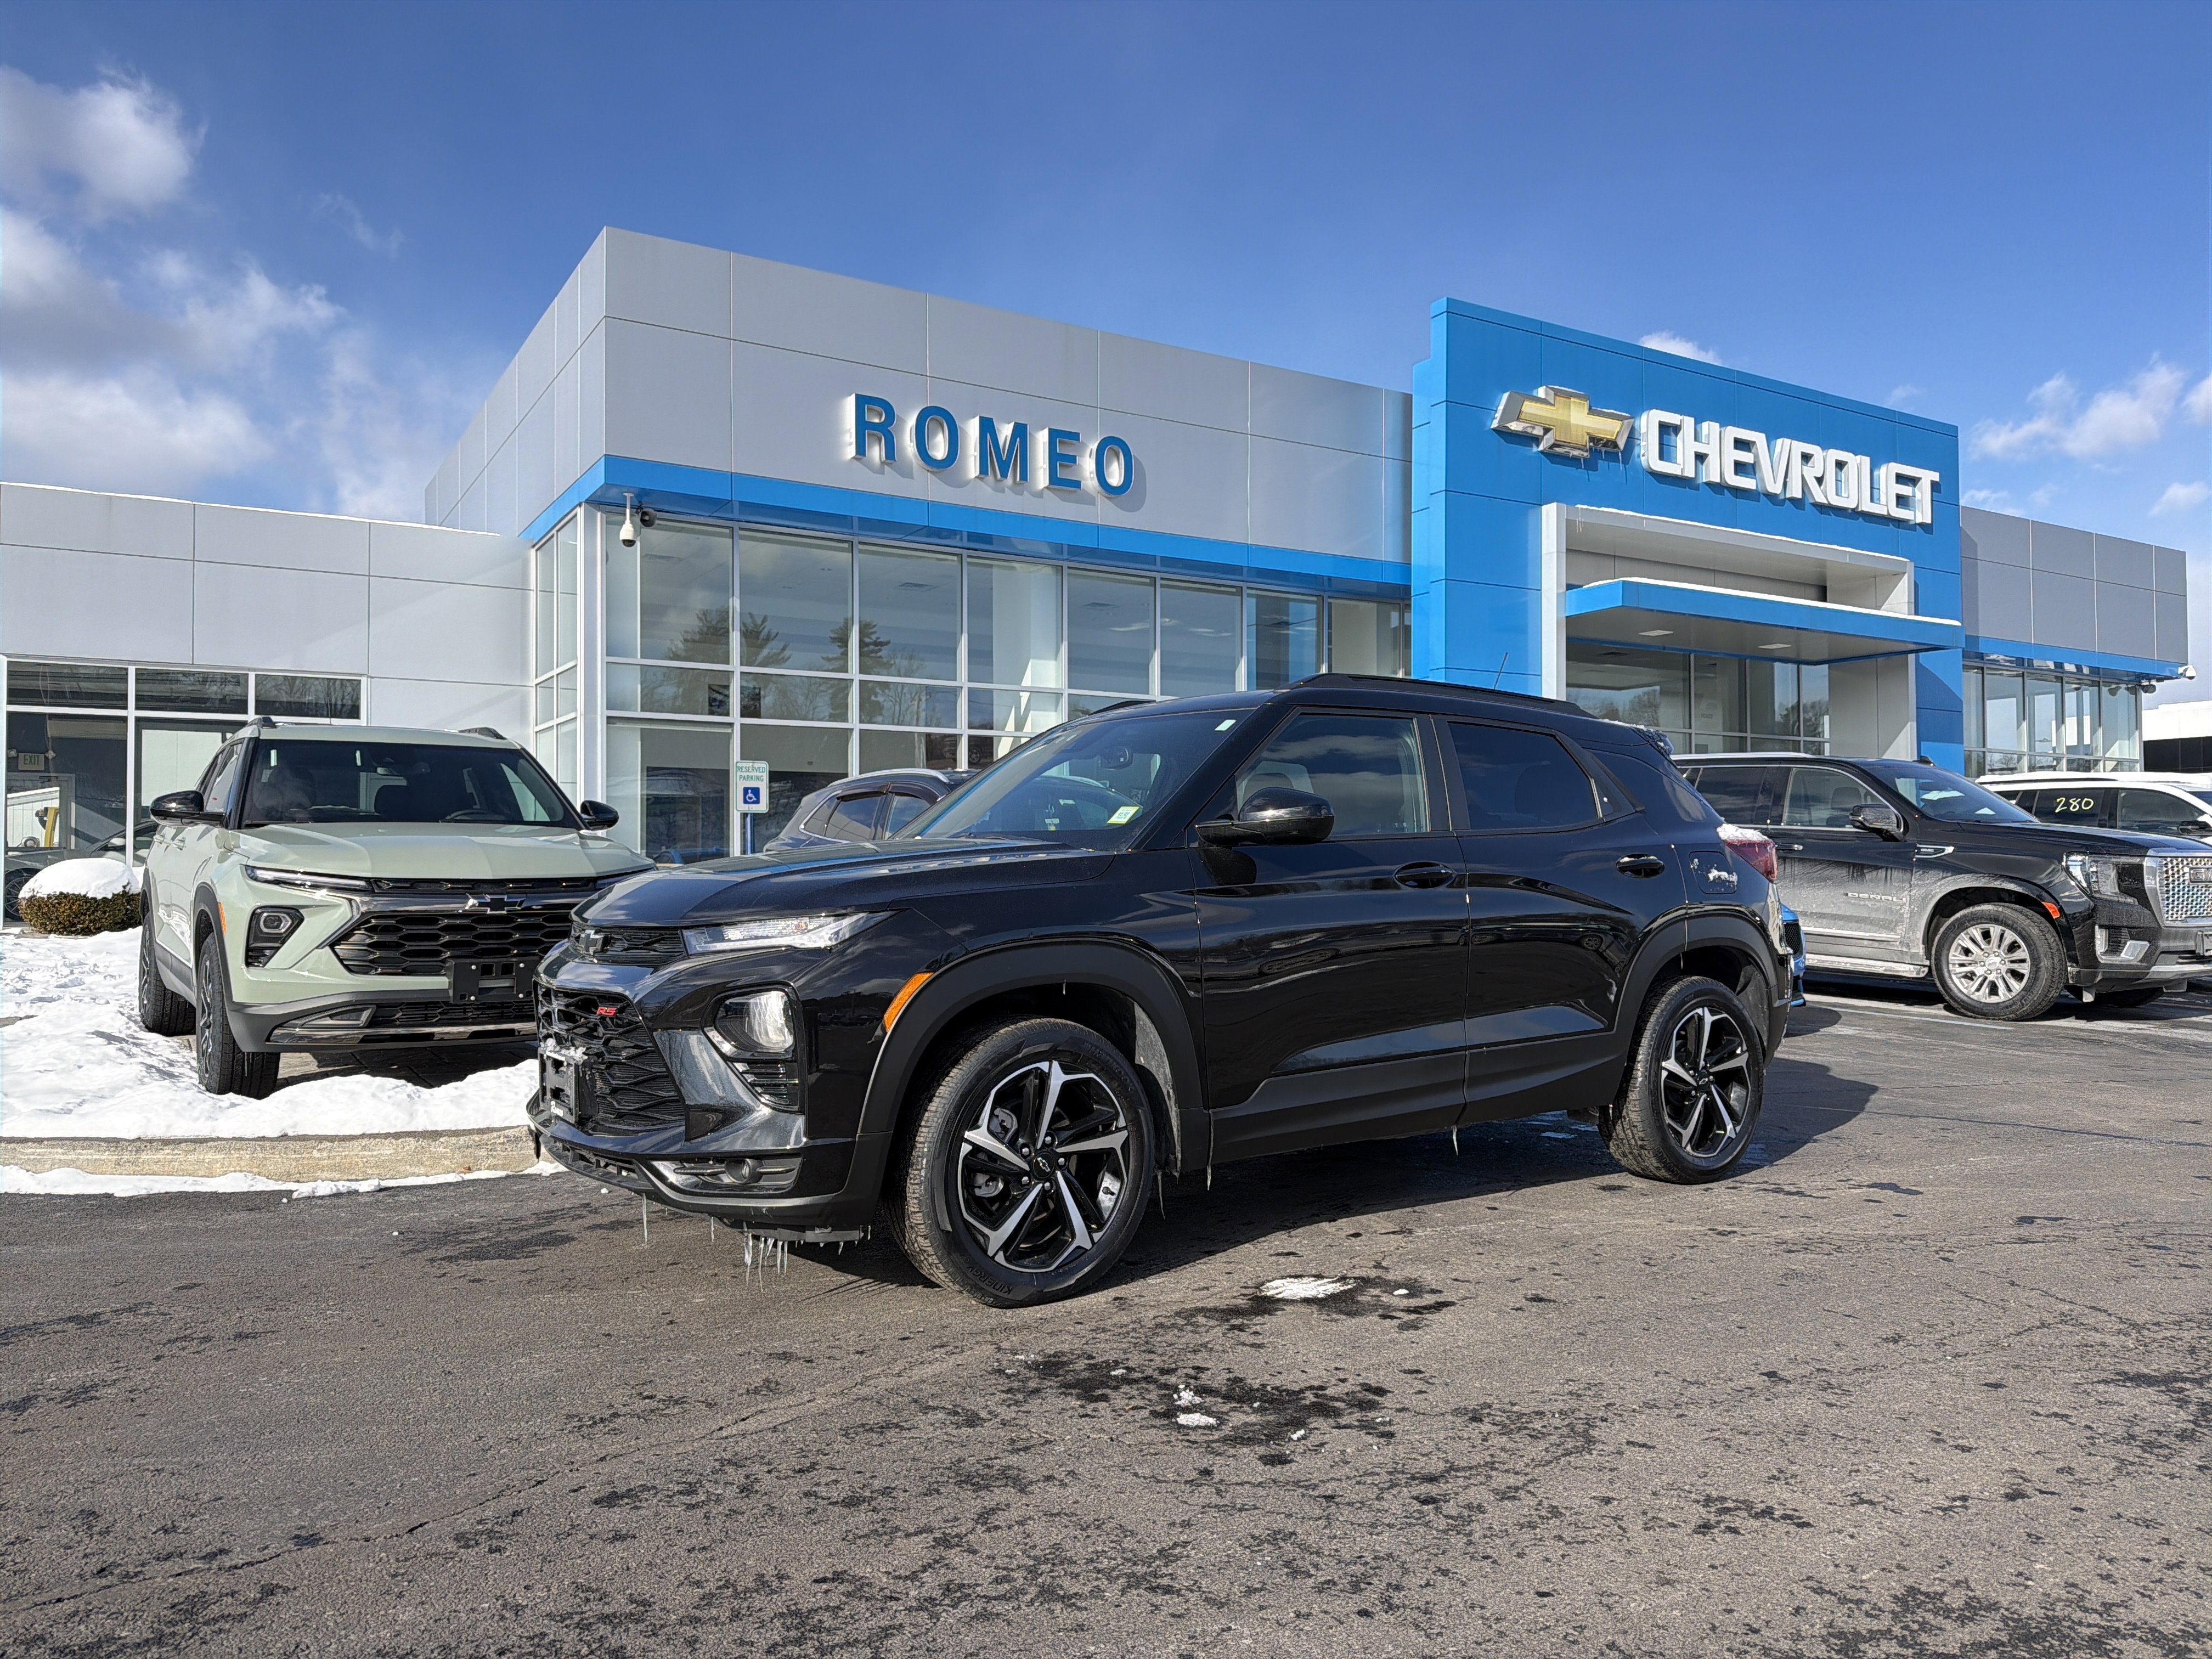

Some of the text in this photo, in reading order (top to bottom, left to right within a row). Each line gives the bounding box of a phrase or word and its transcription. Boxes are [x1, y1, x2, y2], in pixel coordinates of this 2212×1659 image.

[852, 392, 1135, 497] ROMEO
[1642, 409, 1939, 524] CHEVROLET
[23, 754, 41, 765] EXIT
[2055, 797, 2094, 813] 280
[1848, 892, 1906, 903] DENALI
[596, 1006, 616, 1017] RS
